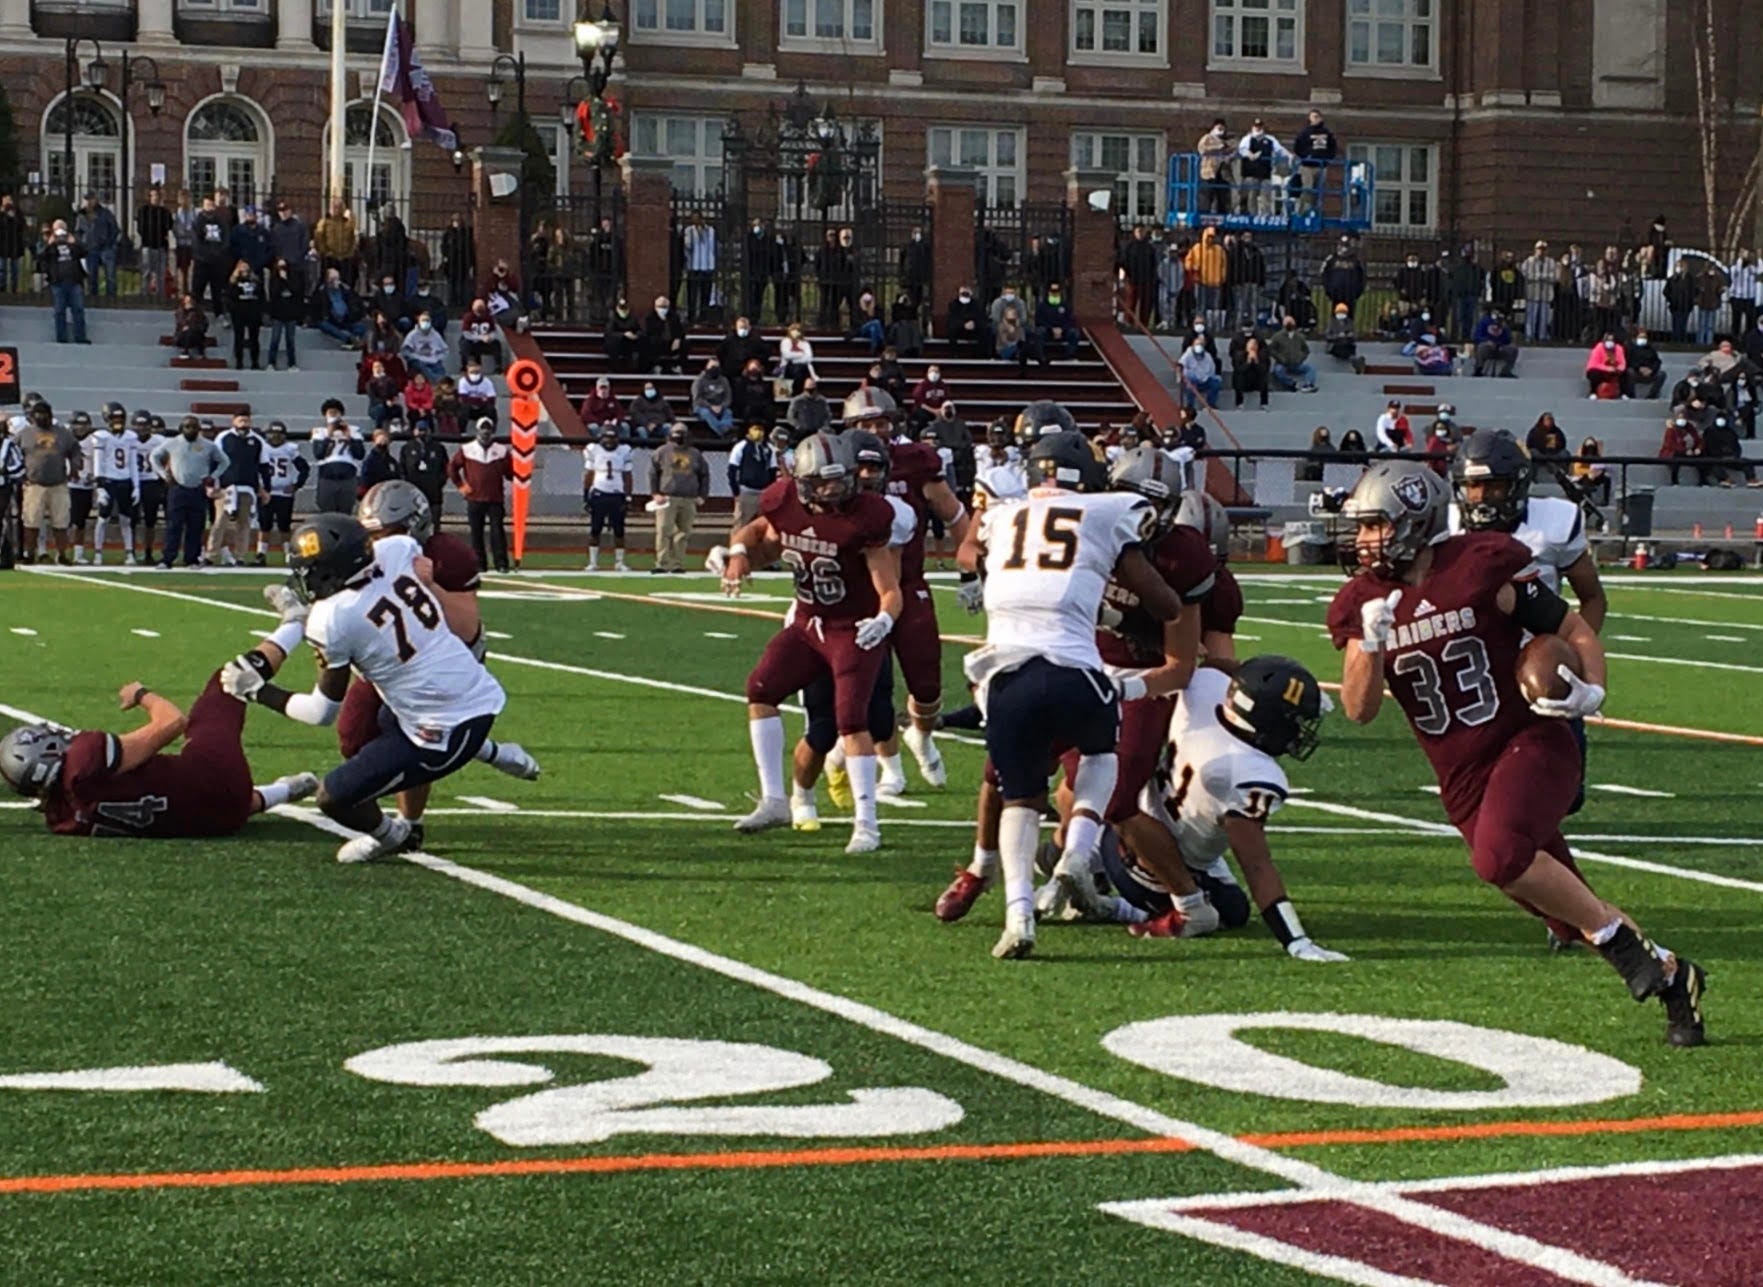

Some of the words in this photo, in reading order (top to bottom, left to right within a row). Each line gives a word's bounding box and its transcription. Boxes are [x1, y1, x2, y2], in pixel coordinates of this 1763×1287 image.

[114, 447, 126, 470] 9
[606, 460, 614, 480] 1
[1001, 506, 1085, 572] 15
[780, 549, 847, 606] 26
[365, 573, 441, 665] 78
[1393, 636, 1501, 736] 33
